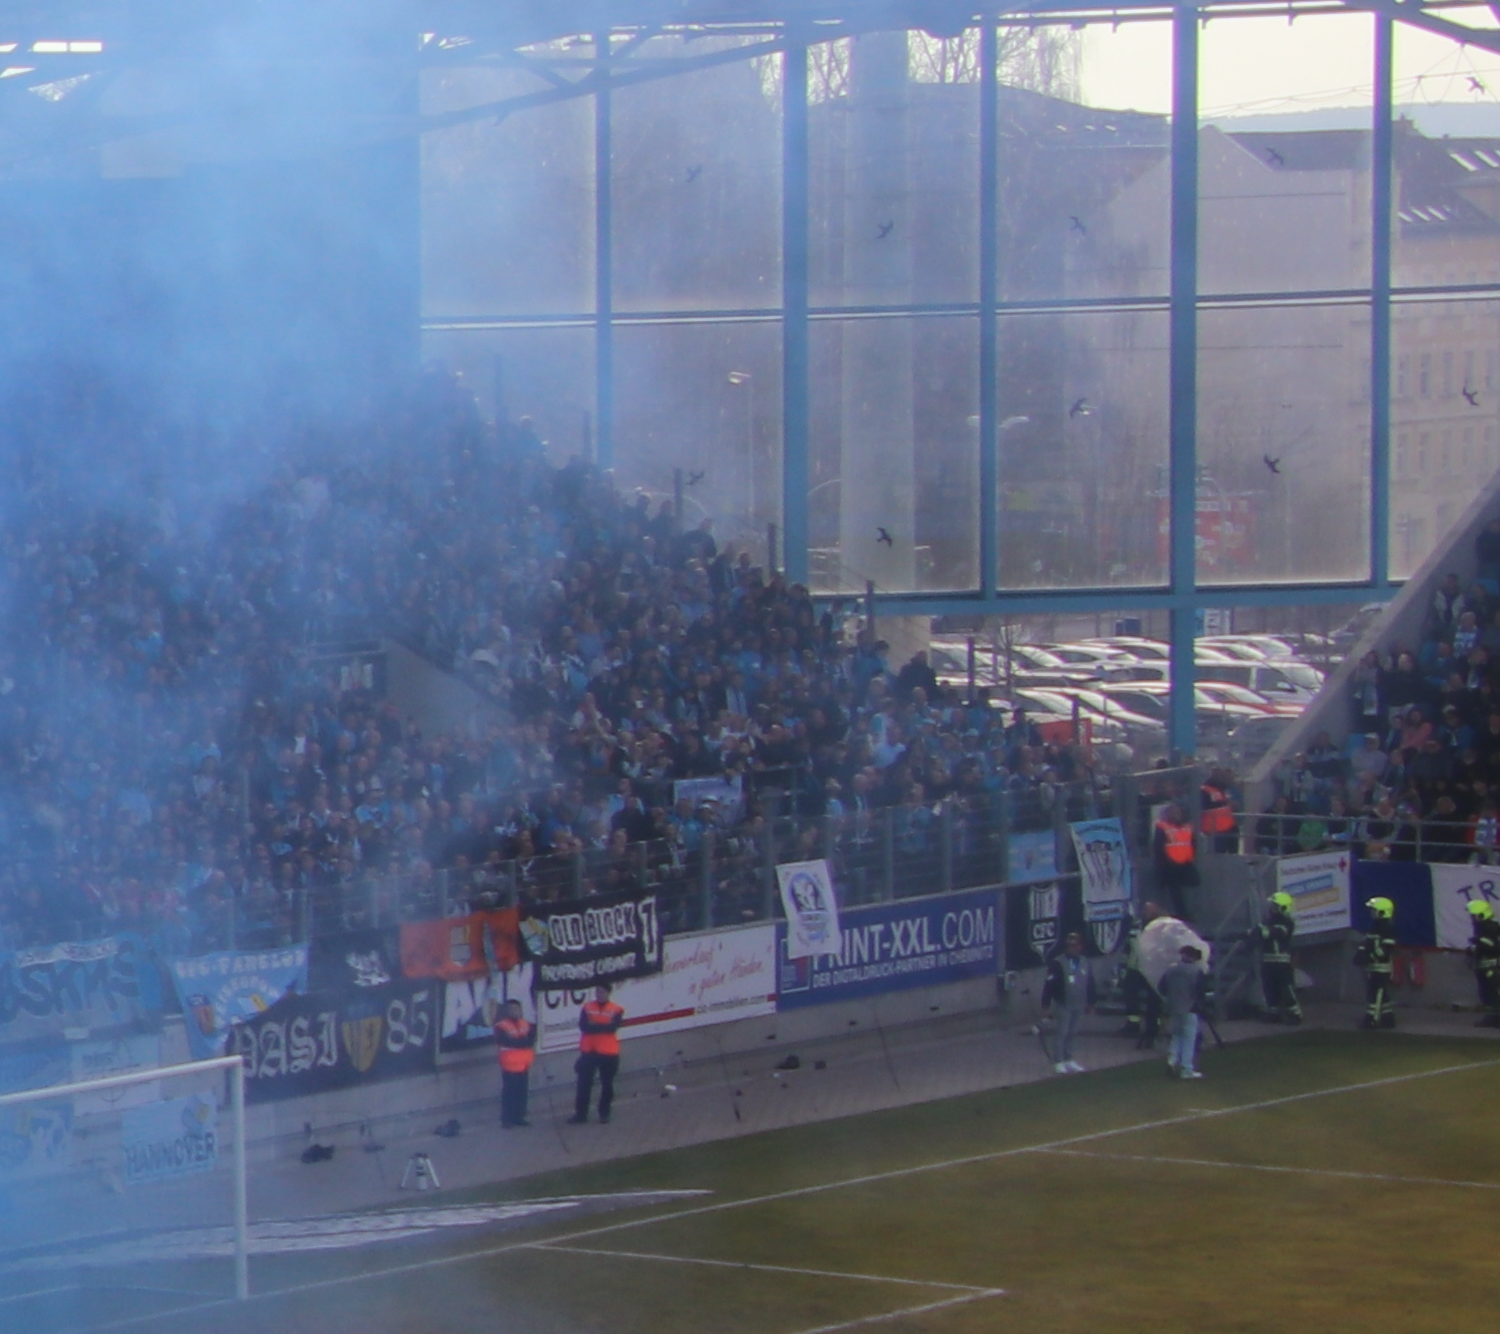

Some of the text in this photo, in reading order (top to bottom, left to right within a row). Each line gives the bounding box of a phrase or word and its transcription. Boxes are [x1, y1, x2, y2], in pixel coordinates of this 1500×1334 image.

[549, 913, 586, 951] OLD
[585, 902, 637, 946] BLOCK
[386, 990, 430, 1054] 85
